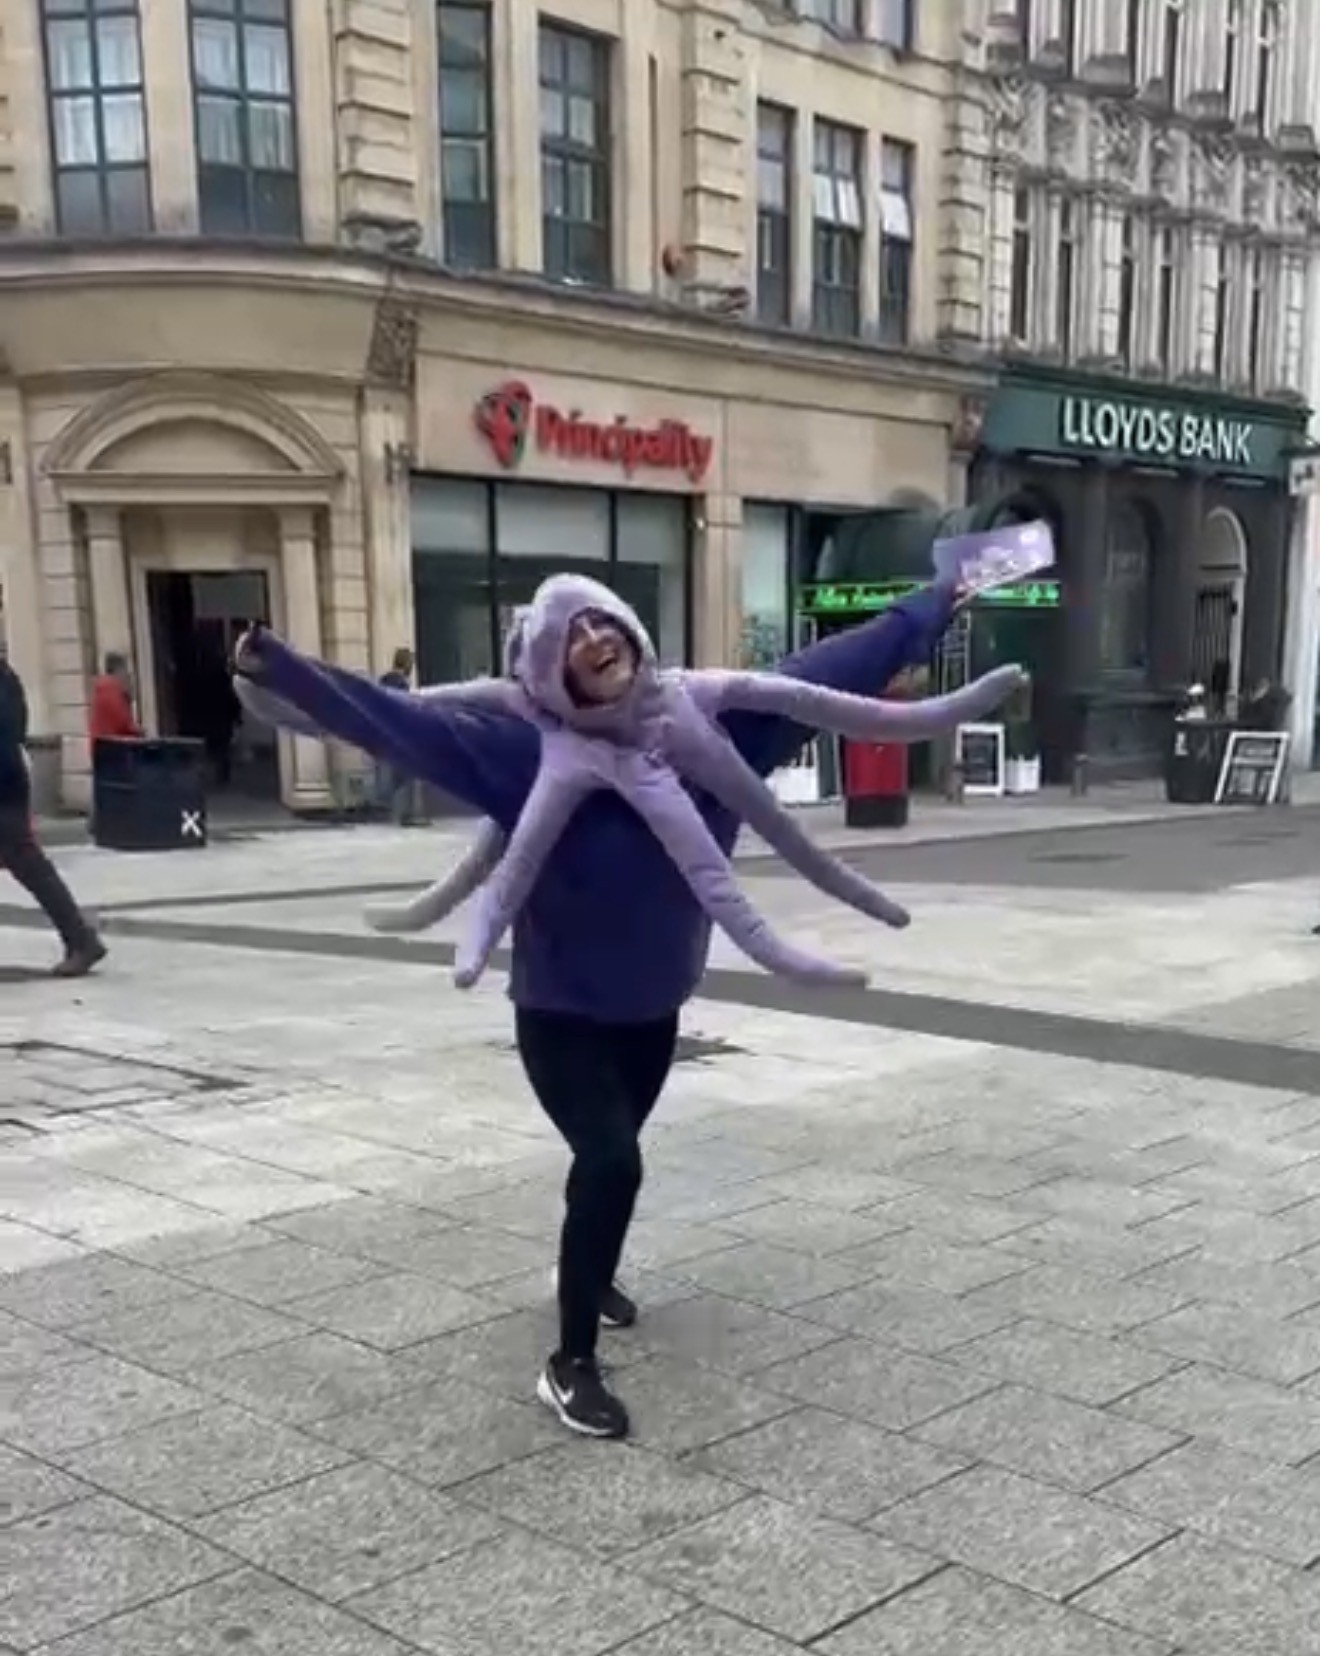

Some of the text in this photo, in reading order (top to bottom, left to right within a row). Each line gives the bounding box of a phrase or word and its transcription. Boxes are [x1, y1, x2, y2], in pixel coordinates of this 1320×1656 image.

[537, 404, 712, 483] Principality
[1063, 397, 1252, 463] LLOYDS BANK
